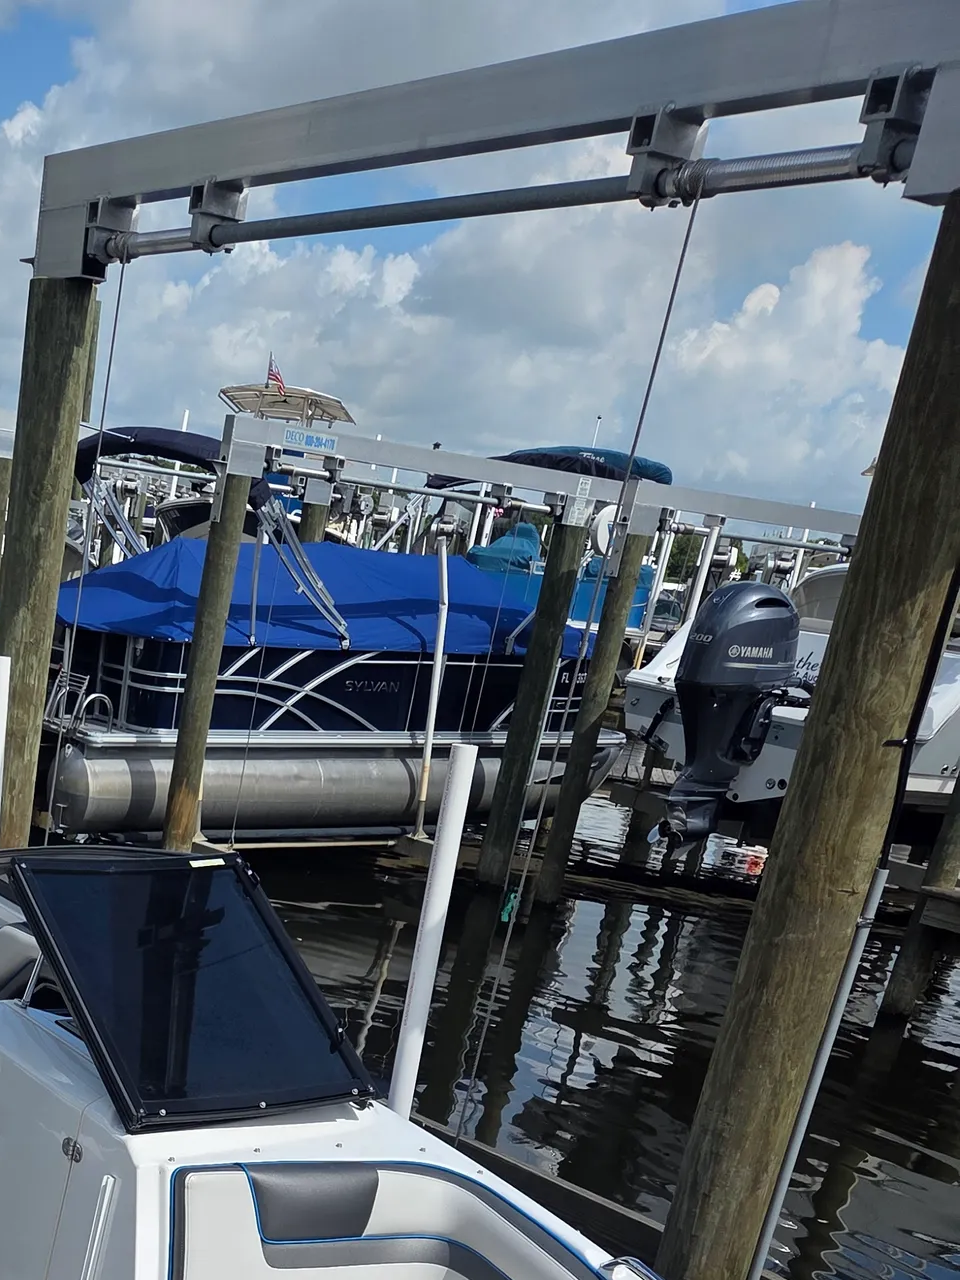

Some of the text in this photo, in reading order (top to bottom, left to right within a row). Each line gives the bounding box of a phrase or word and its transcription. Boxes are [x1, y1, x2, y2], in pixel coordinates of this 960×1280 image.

[285, 429, 305, 442] DECO
[689, 632, 713, 643] 200
[740, 645, 774, 659] YAMAHA
[345, 680, 400, 692] SYLVAN
